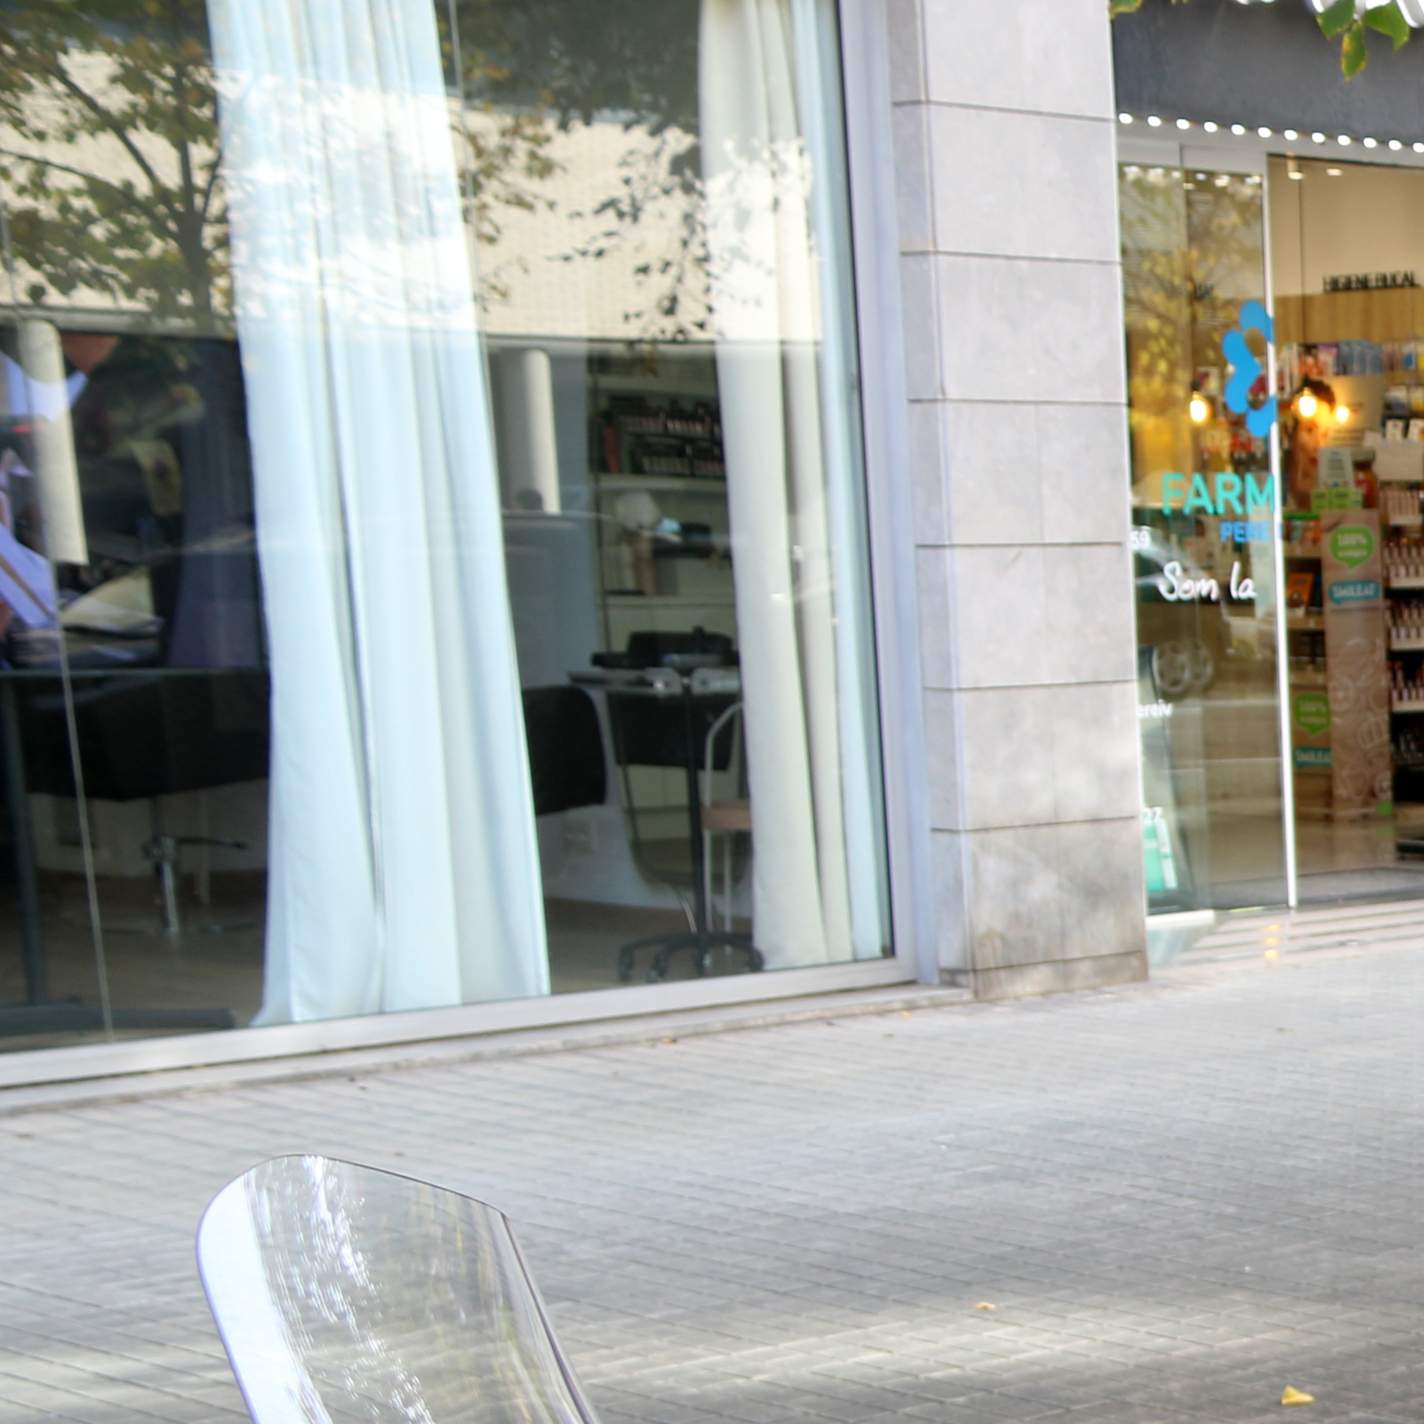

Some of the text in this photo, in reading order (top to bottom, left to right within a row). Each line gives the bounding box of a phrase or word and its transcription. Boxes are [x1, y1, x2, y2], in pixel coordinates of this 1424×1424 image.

[1160, 471, 1277, 516] FARM
[1159, 560, 1219, 602] Som
[1229, 560, 1259, 600] la
